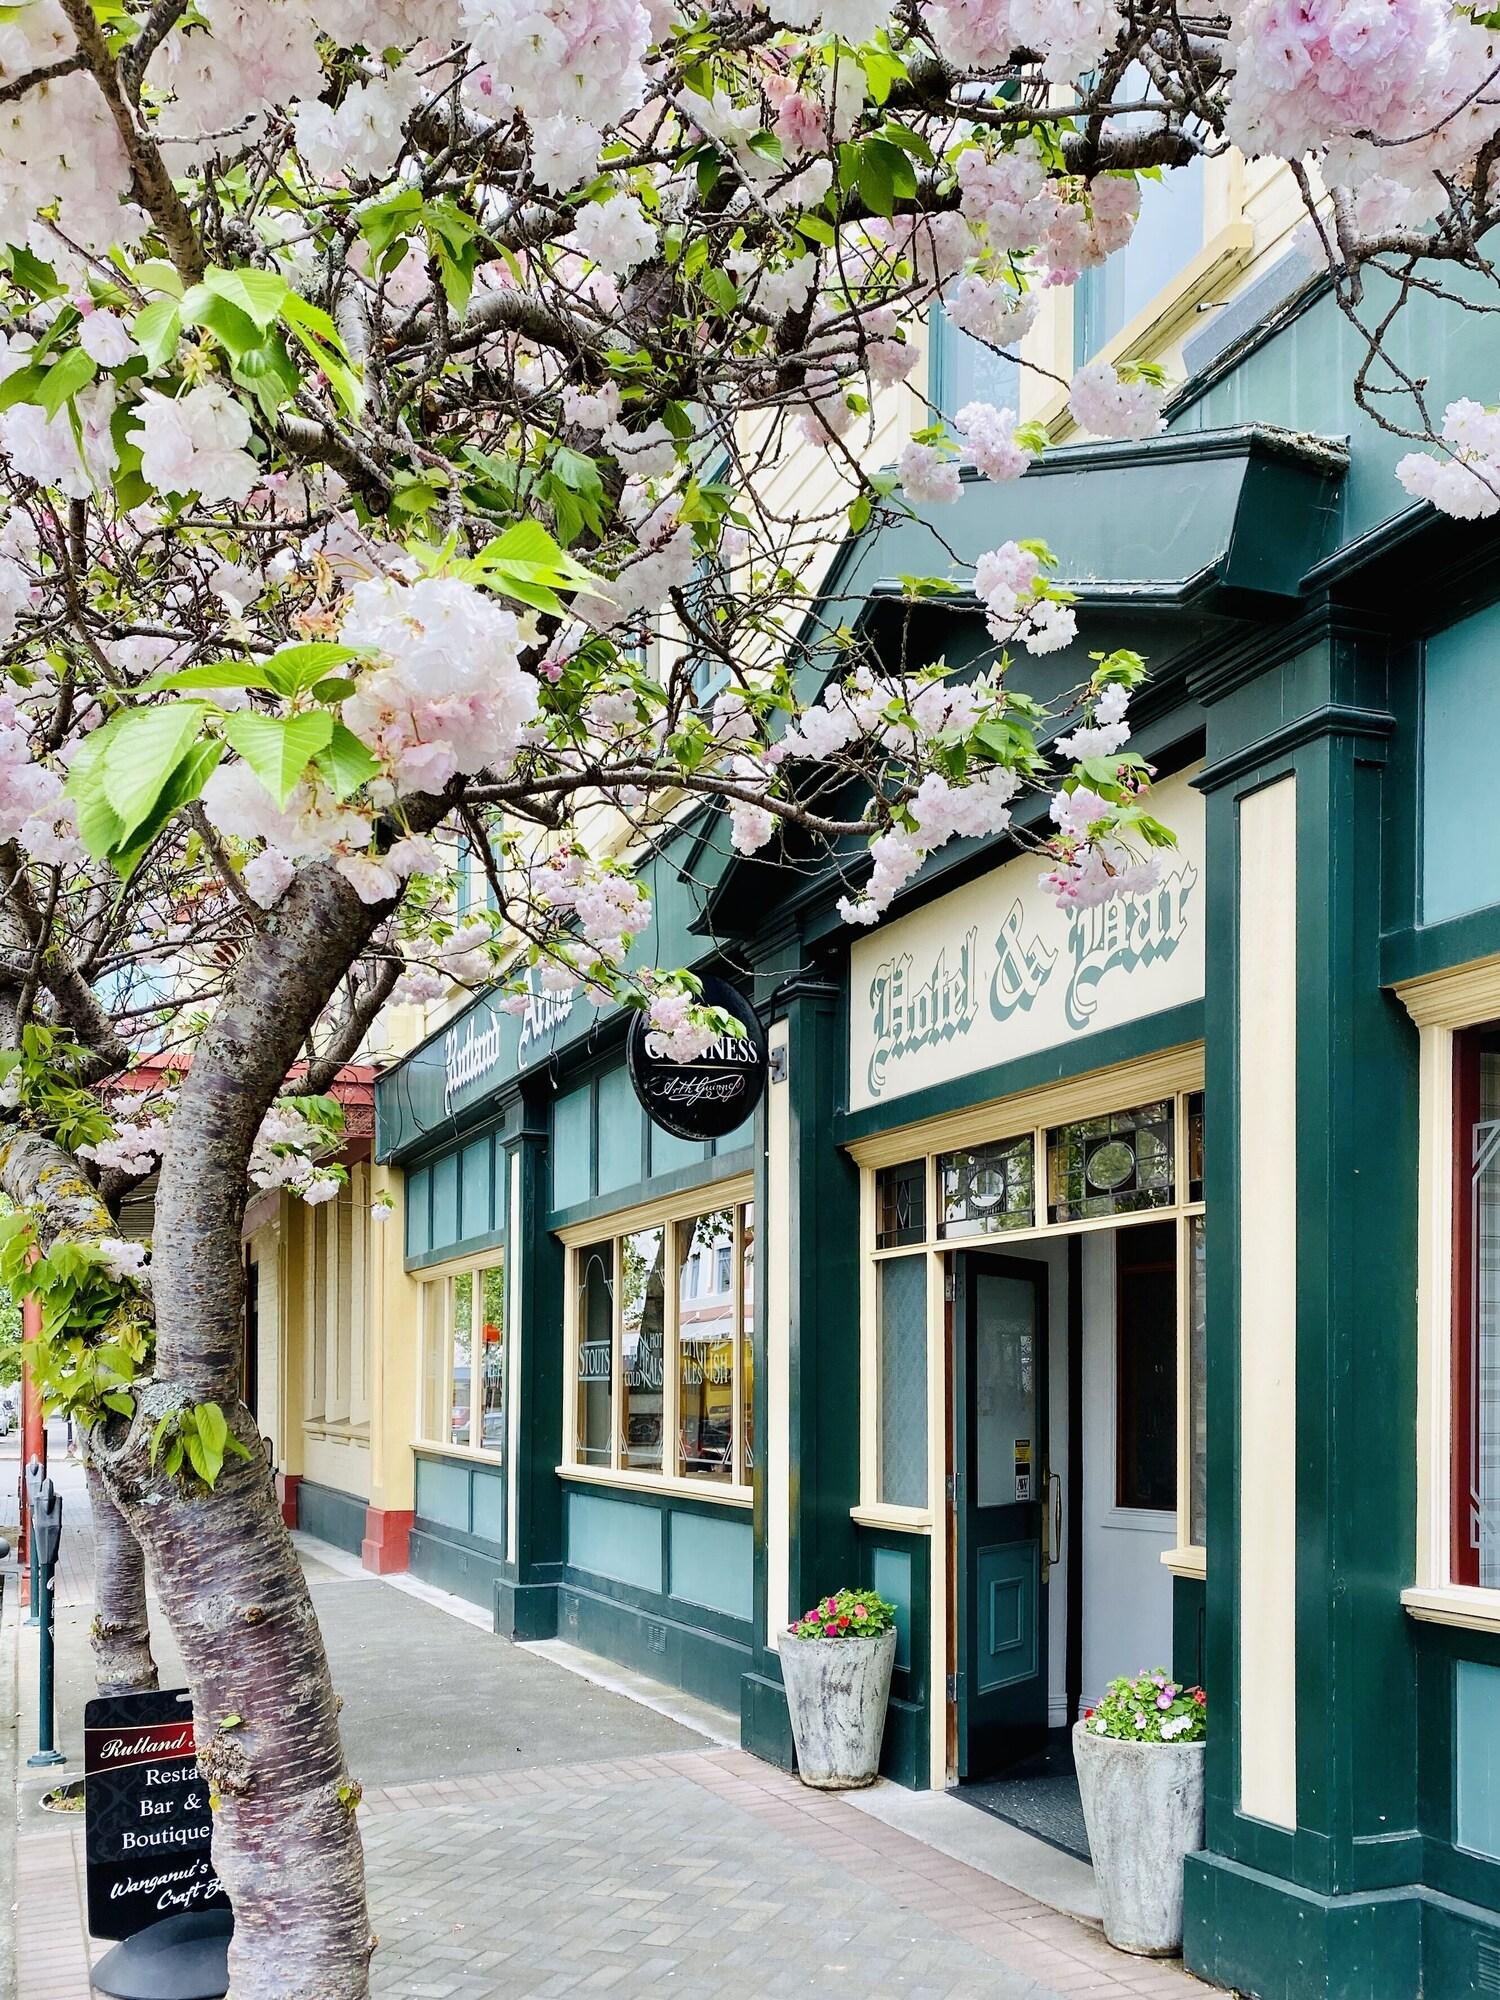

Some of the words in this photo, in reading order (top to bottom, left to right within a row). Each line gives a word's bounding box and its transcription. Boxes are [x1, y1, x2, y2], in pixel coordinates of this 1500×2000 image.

[868, 925, 978, 1096] Hotel
[990, 898, 1059, 1021] &
[445, 1007, 500, 1116] Rutland
[649, 1332, 663, 1349] HOT
[640, 1341, 664, 1386] MEALS
[682, 1358, 703, 1385] ALES
[624, 1371, 641, 1387] COLD
[100, 1731, 187, 1759] Rutland
[140, 1799, 174, 1817] Bar
[183, 1793, 202, 1811] &
[122, 1824, 210, 1850] Boutique
[110, 1858, 208, 1899] Wanganui's
[157, 1879, 206, 1910] Craft
